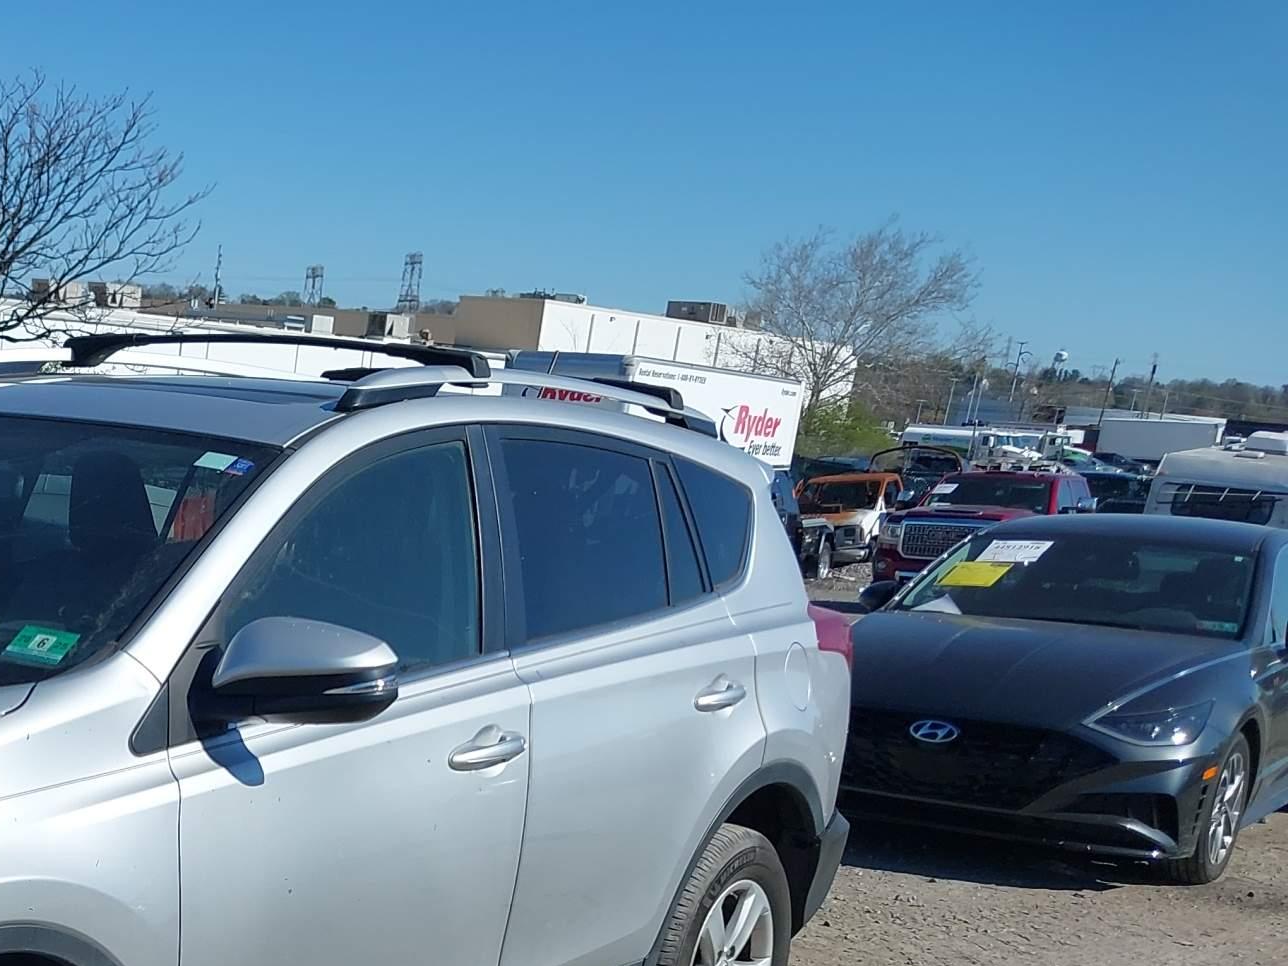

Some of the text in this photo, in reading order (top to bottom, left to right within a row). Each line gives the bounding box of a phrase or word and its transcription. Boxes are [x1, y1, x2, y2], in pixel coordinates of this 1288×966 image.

[733, 405, 782, 443] Ryder
[747, 440, 762, 456] Ever
[36, 637, 50, 649] 6
